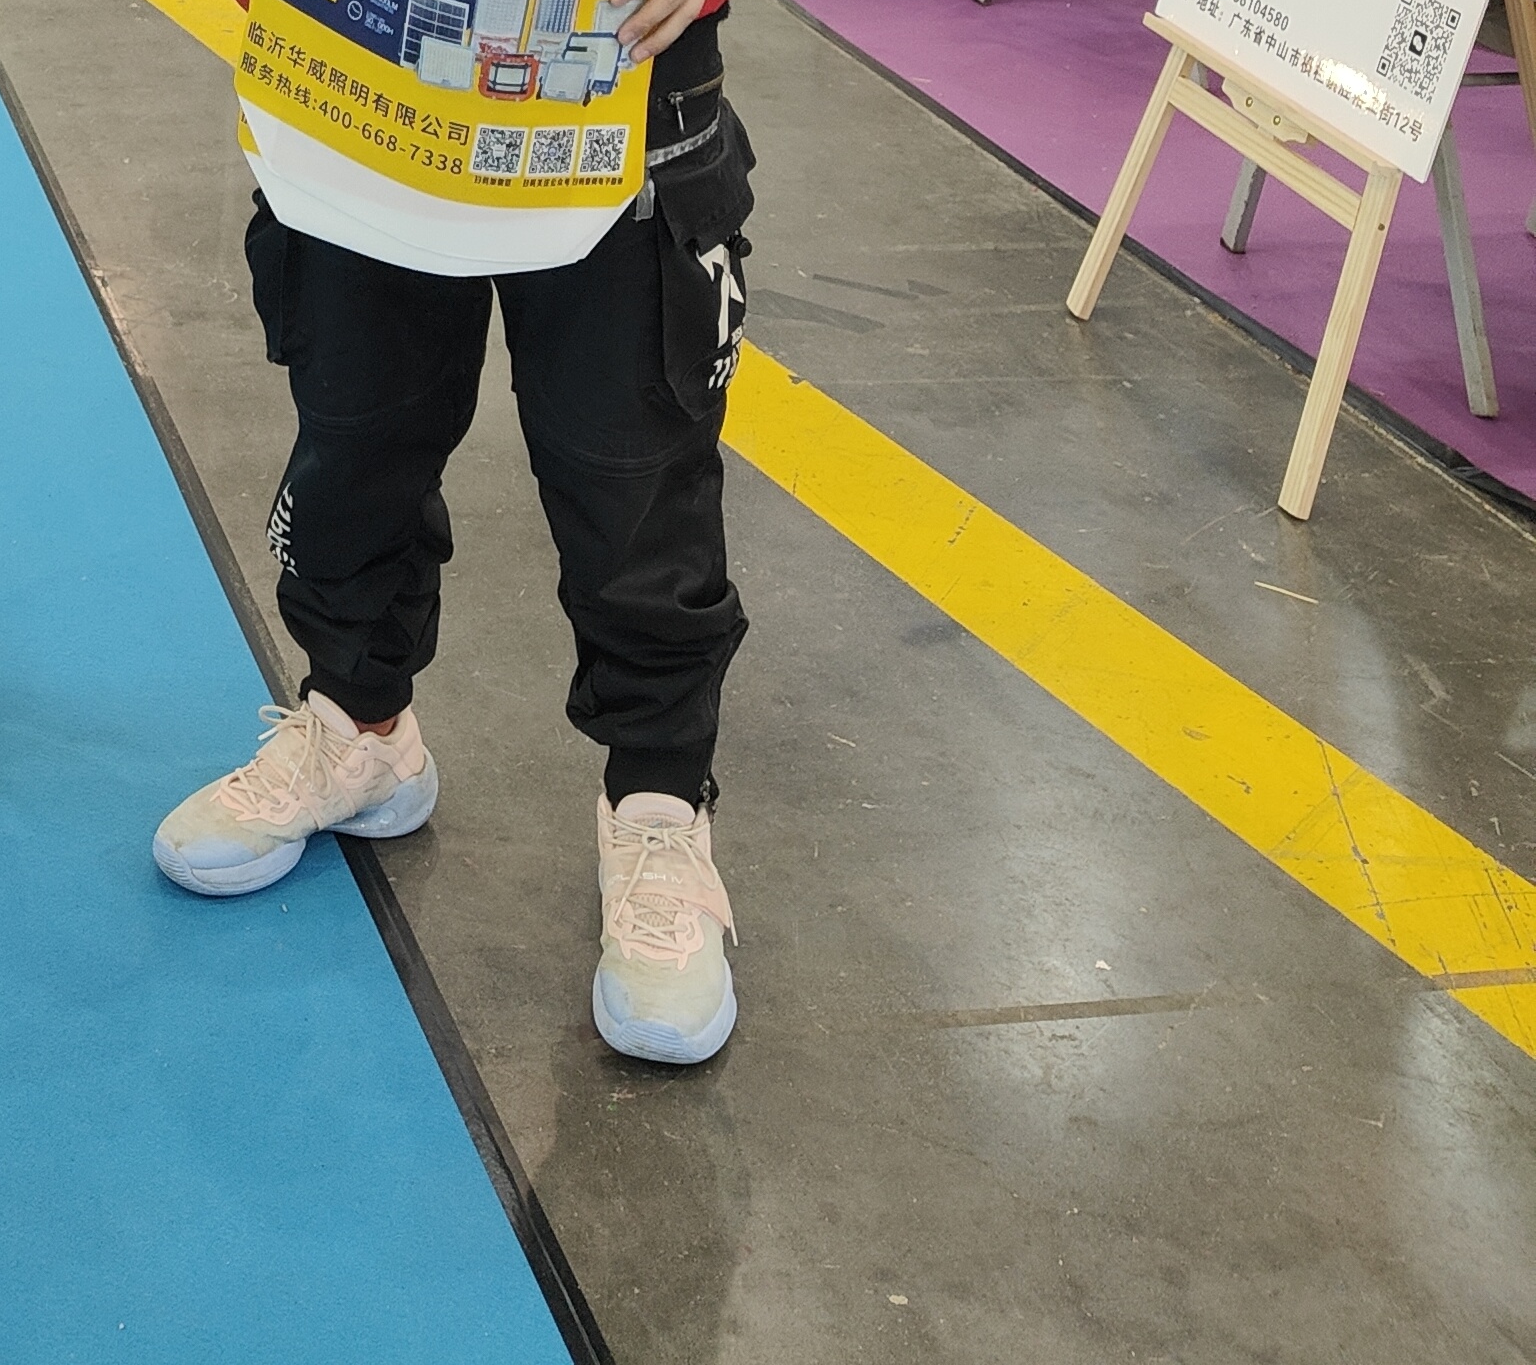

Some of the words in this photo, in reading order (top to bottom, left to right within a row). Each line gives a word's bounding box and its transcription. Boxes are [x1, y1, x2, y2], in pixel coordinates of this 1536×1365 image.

[246, 21, 471, 148] 临沂华威照明有限公司
